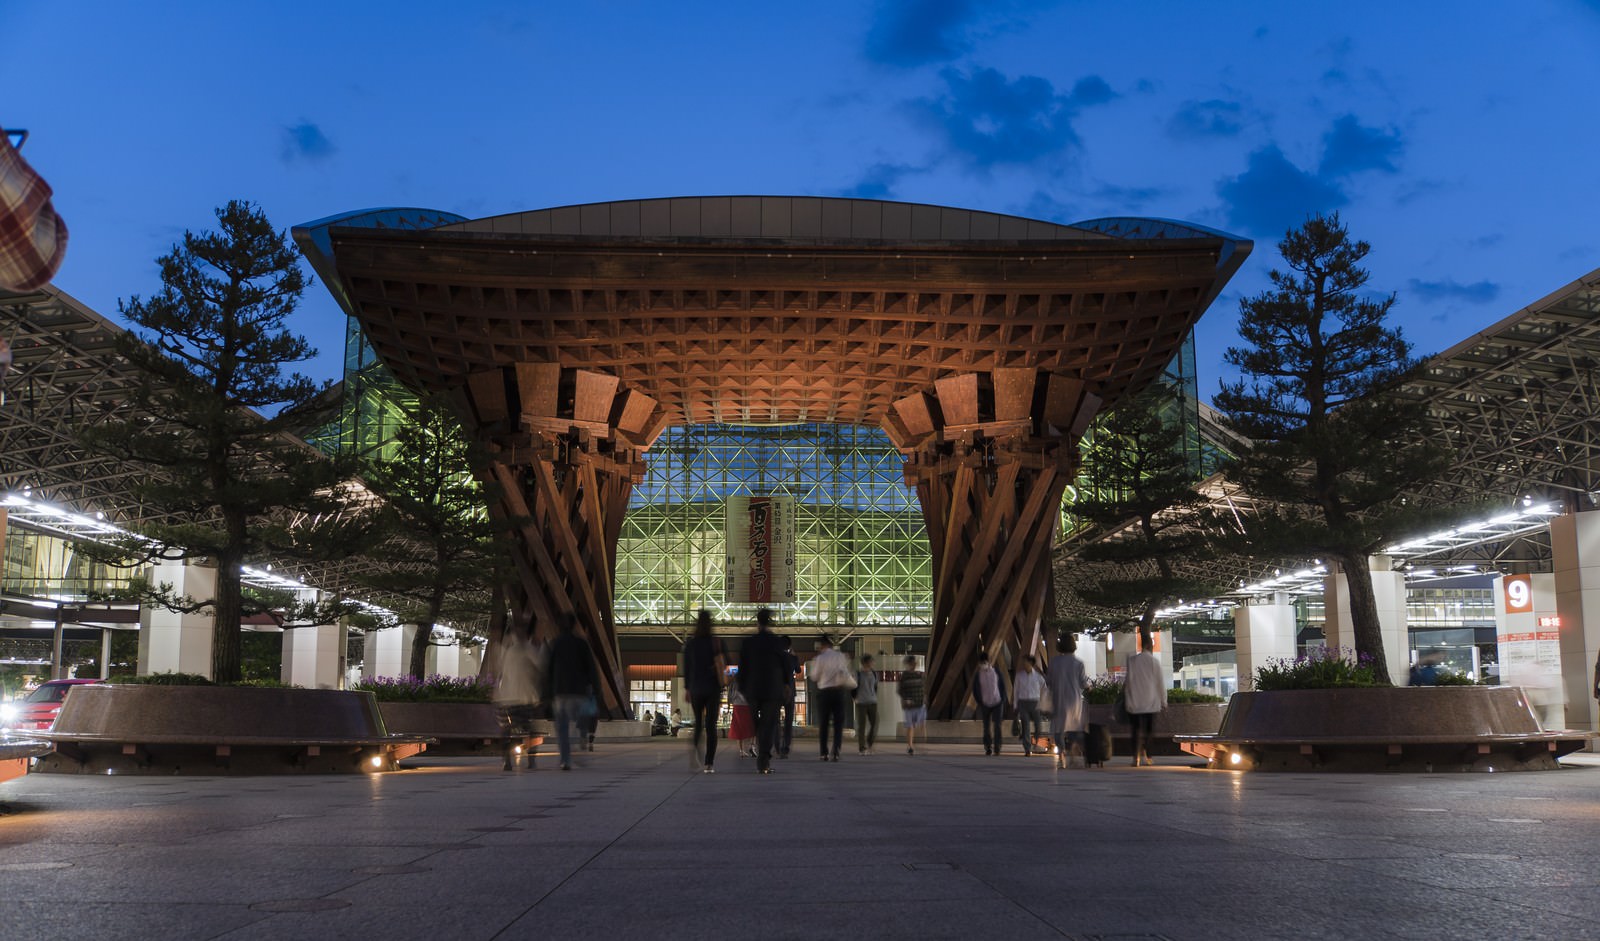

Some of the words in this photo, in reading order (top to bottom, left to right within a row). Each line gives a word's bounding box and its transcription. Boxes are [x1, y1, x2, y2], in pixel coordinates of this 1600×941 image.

[748, 502, 770, 600] 百万石まつり
[1508, 580, 1529, 608] 9
